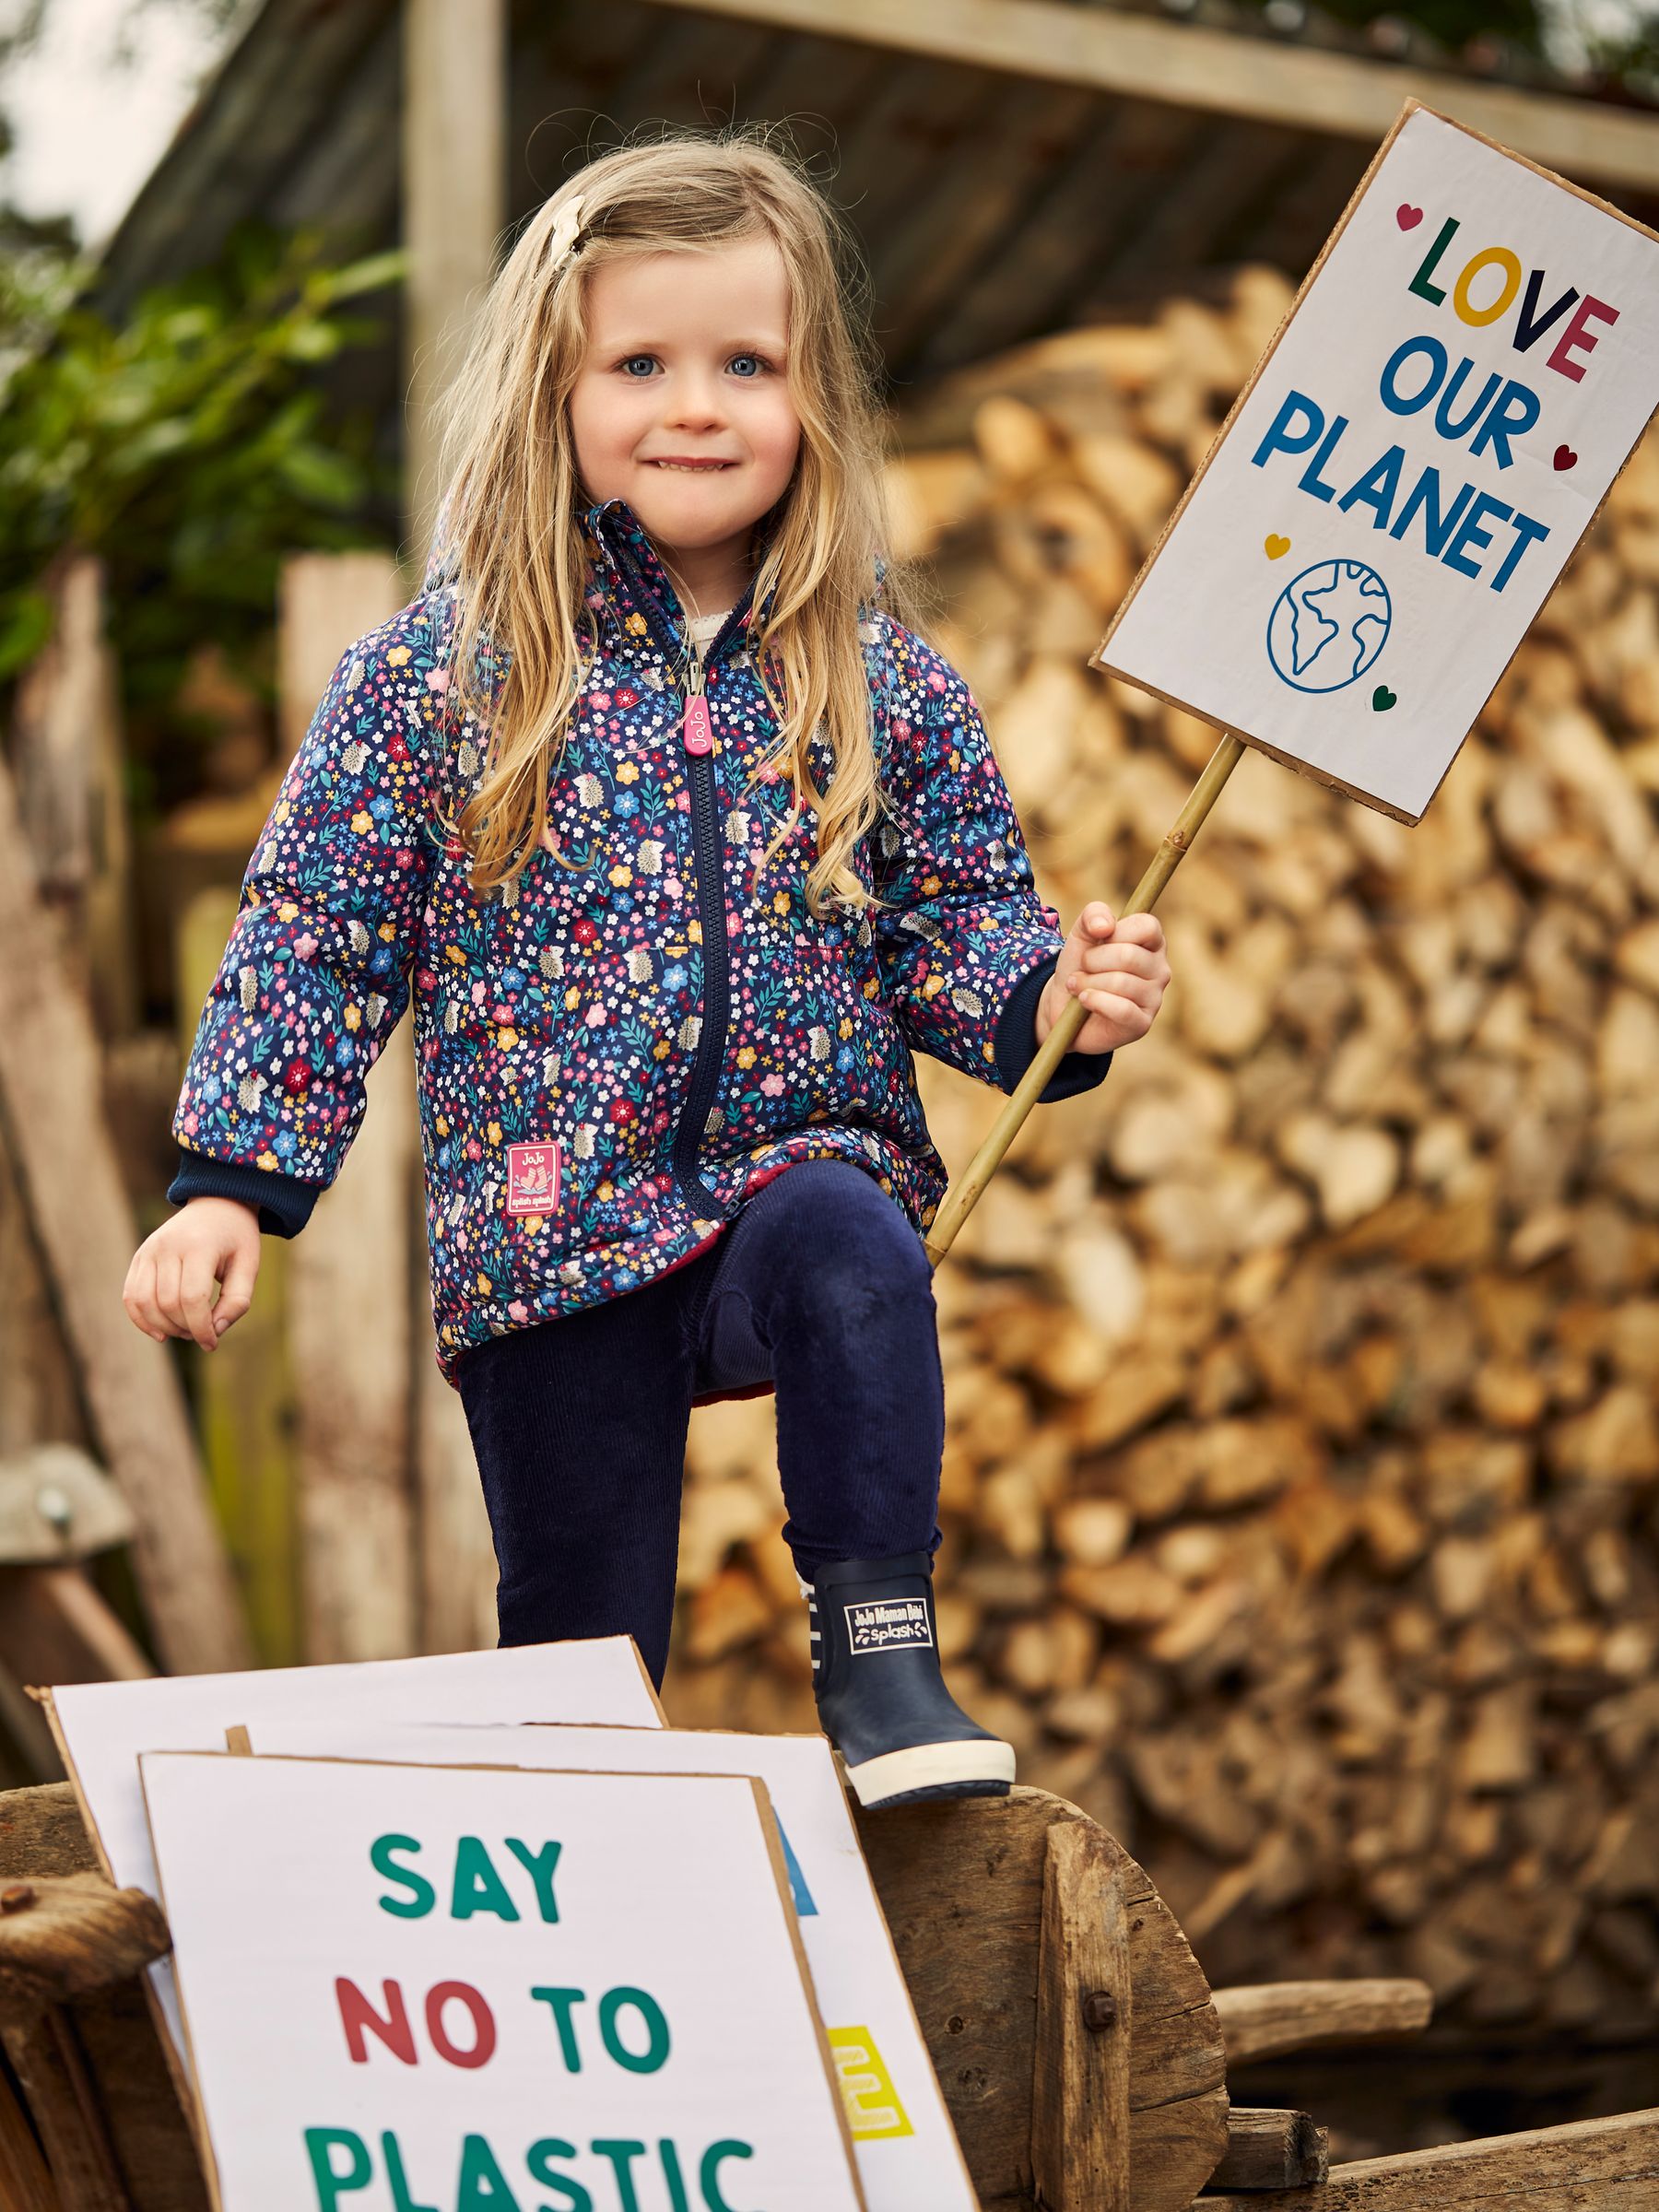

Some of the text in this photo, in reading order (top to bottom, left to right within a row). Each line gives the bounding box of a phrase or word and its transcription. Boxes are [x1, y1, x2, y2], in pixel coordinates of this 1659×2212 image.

[1408, 218, 1620, 383] LOVE
[1380, 335, 1541, 470] OUR
[1251, 390, 1551, 593] PLANET
[690, 712, 708, 747] JoJo
[522, 1152, 545, 1166] JoJo
[854, 1608, 875, 1628] JoJo
[874, 1606, 908, 1624] Maman
[870, 1623, 914, 1646] splash
[371, 1834, 561, 1924] SAY
[335, 1977, 671, 2074] NO TO
[304, 2127, 754, 2212] PLASTIC
